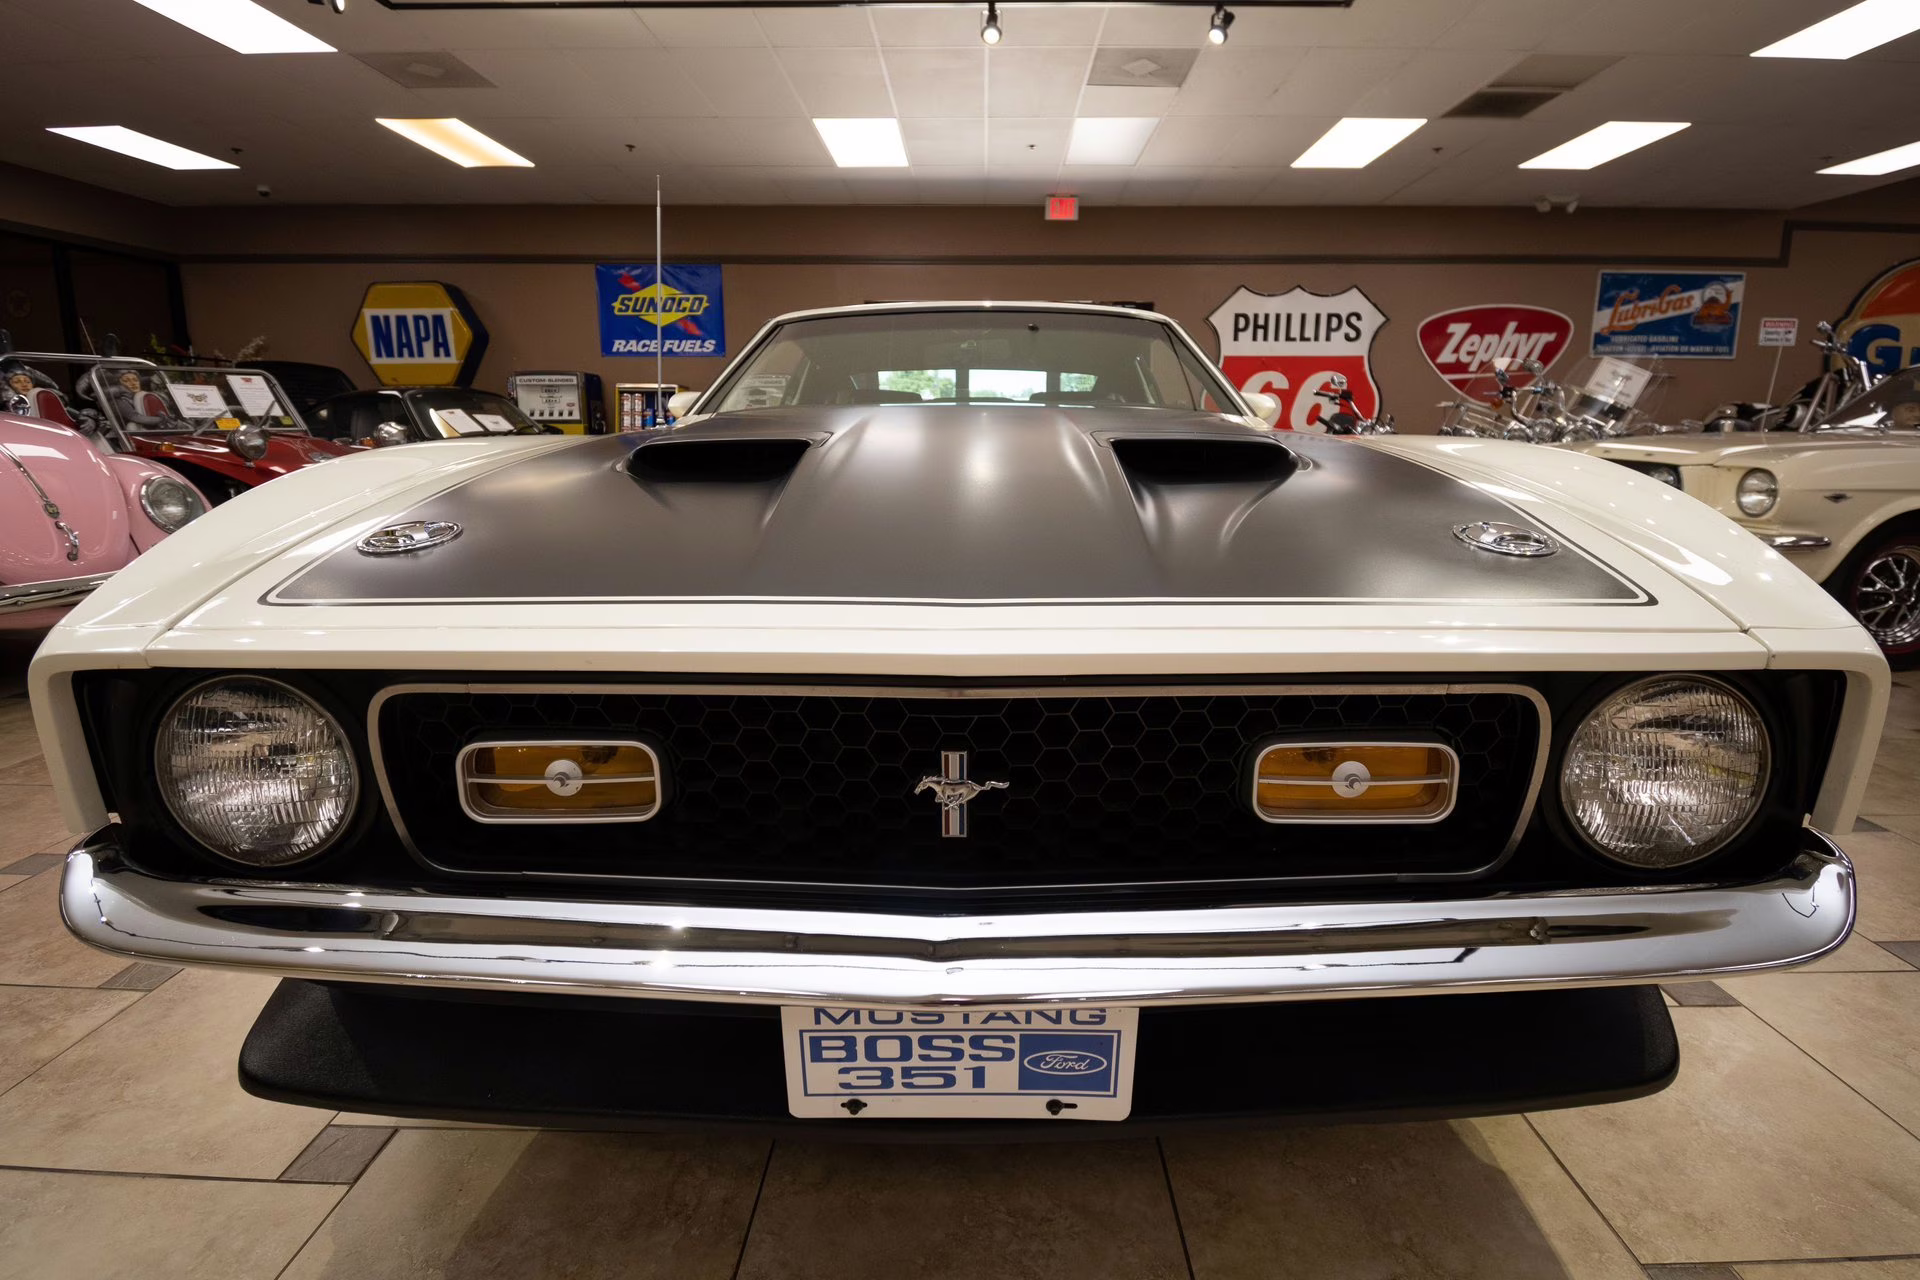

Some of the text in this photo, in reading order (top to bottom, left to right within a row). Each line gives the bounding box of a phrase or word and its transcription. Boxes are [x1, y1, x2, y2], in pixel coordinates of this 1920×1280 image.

[617, 296, 705, 313] SUNOCO
[370, 314, 451, 358] NAPA
[1233, 312, 1363, 342] PHILLIPS
[612, 340, 716, 352] RACE FUELS
[1436, 321, 1557, 372] Zephyr
[1847, 323, 1920, 378] G
[813, 1008, 1107, 1025] MUSTANG
[809, 1035, 1016, 1063] BOSS
[1040, 1054, 1090, 1070] Ford
[838, 1067, 987, 1090] 351
